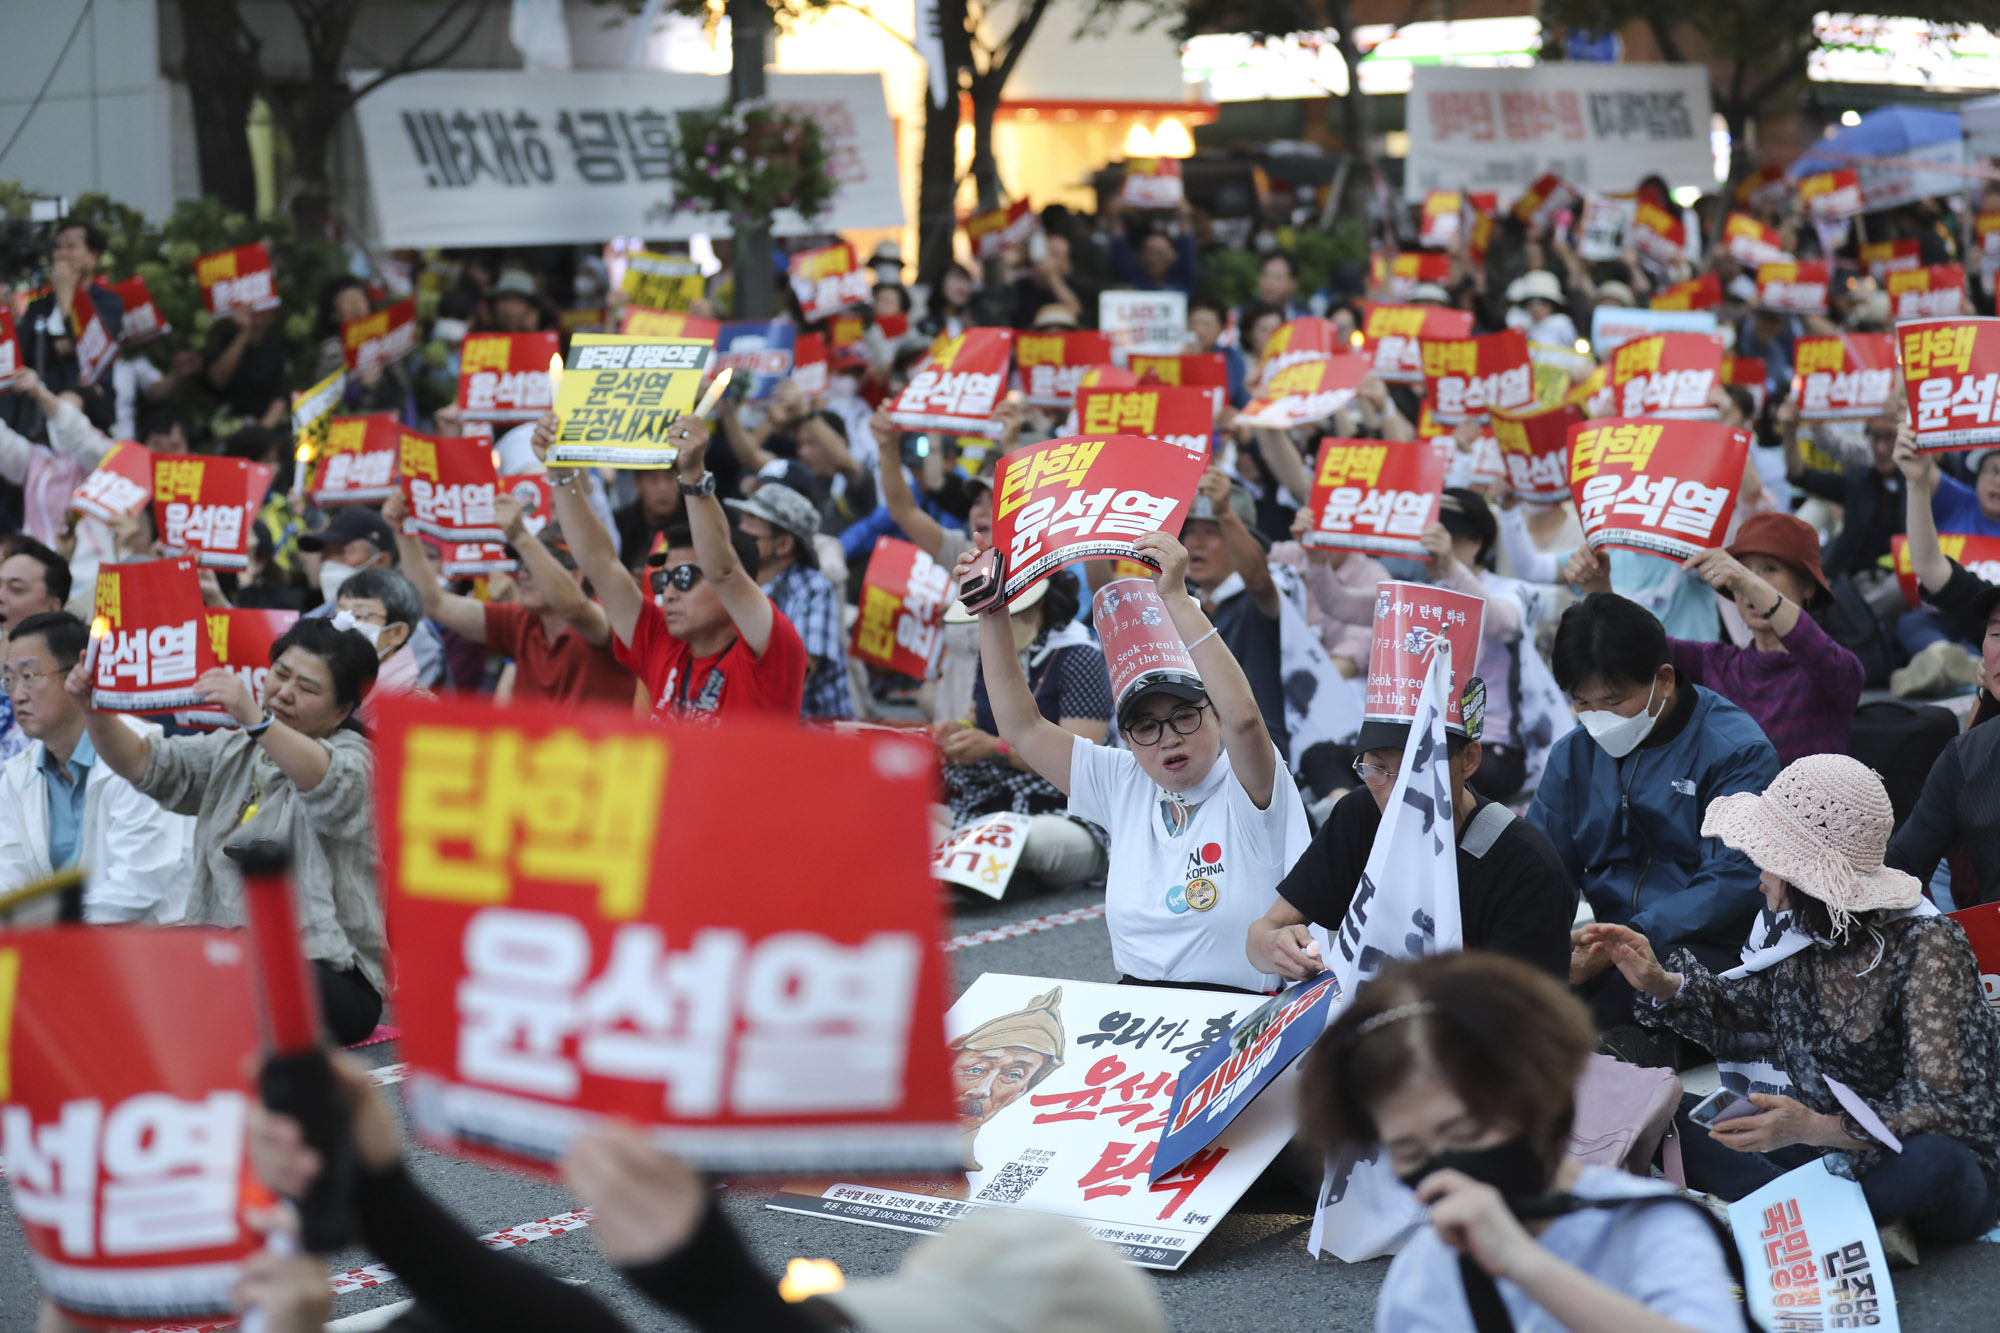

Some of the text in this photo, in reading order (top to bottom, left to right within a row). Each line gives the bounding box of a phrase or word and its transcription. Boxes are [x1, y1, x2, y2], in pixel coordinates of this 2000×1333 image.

[575, 346, 631, 369] 범국민
[627, 345, 702, 369] 항쟁으로
[1374, 337, 1424, 373] 윤석
[1423, 342, 1478, 377] 탄핵
[1615, 338, 1665, 384] 탄핵
[1904, 326, 1977, 381] 탄핵
[467, 372, 552, 410] 윤석열
[585, 372, 674, 406] 윤석열
[898, 372, 999, 414] 윤석열
[1030, 366, 1083, 399] 윤석
[1437, 364, 1532, 413] 윤석열
[1624, 370, 1716, 416] 윤석열
[1802, 369, 1894, 411] 윤석열
[1918, 373, 2000, 430] 윤석
[1084, 392, 1159, 435] 탄핵
[325, 450, 397, 491] 윤석열
[1318, 446, 1387, 488] 탄핵
[1571, 424, 1664, 484] 탄핵
[155, 461, 205, 503] 탄핵
[997, 440, 1106, 522] 탄핵
[411, 481, 497, 526] 윤석열
[1321, 486, 1434, 535] 윤석열
[1580, 473, 1730, 540] 윤석열
[164, 503, 245, 550] 윤석열
[1008, 487, 1180, 574] 윤석열
[1121, 591, 1143, 603] 새끼
[1390, 602, 1467, 627] 새끼 탄핵 하라
[98, 619, 198, 687] 윤석열
[207, 616, 229, 662] 핵
[1116, 640, 1175, 665] Seok-yeol
[1138, 653, 1160, 665] the
[1367, 692, 1383, 704] each
[1386, 693, 1407, 706] the
[1371, 673, 1425, 690] Seok-yeo
[402, 727, 667, 918] 탄핵
[1185, 862, 1225, 881] KOPINA
[456, 908, 922, 1117] 윤석열
[1077, 1010, 1189, 1050] 우리가
[1023, 1148, 1057, 1158] 윤석열 탄핵
[0, 1091, 247, 1258] 석열
[821, 1201, 941, 1227] 후원 신한은행 100-036-164860
[833, 1187, 866, 1201] 윤석열
[865, 1191, 885, 1206] 퇴진,
[885, 1196, 914, 1210] 김건희
[913, 1200, 937, 1213] 특검
[1097, 1228, 1152, 1245] 시청역-숭례문
[1149, 1234, 1162, 1246] 앞
[1161, 1235, 1186, 1248] 대로)
[1115, 1244, 1168, 1262] 여러 번 가능)
[1763, 1198, 1822, 1308] 국민항쟁
[1822, 1240, 1882, 1330] 민주당은
